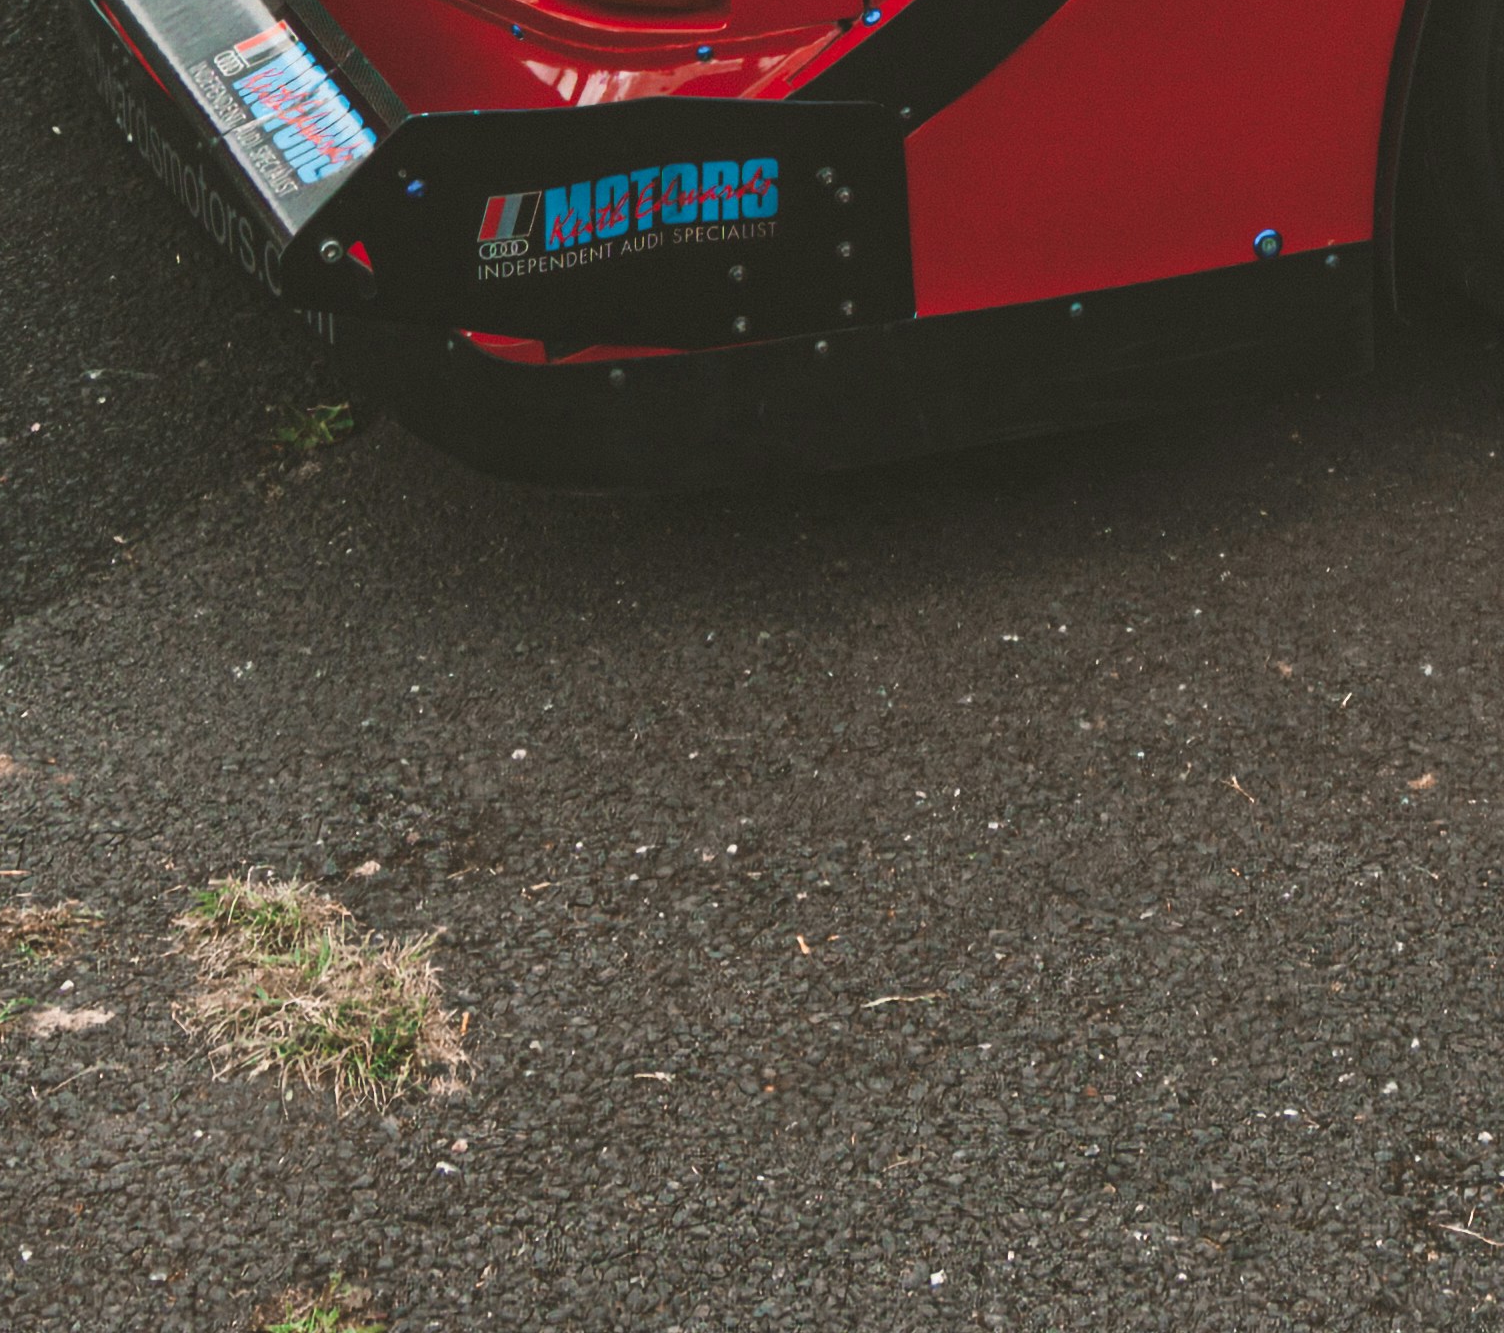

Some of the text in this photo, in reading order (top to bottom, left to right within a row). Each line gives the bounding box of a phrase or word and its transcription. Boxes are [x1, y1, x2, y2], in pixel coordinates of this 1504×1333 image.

[545, 157, 779, 252] MOTORS
[549, 164, 773, 245] Keith Edwards
[477, 221, 779, 281] INDEPENDENT AUDI SPECIALIST
